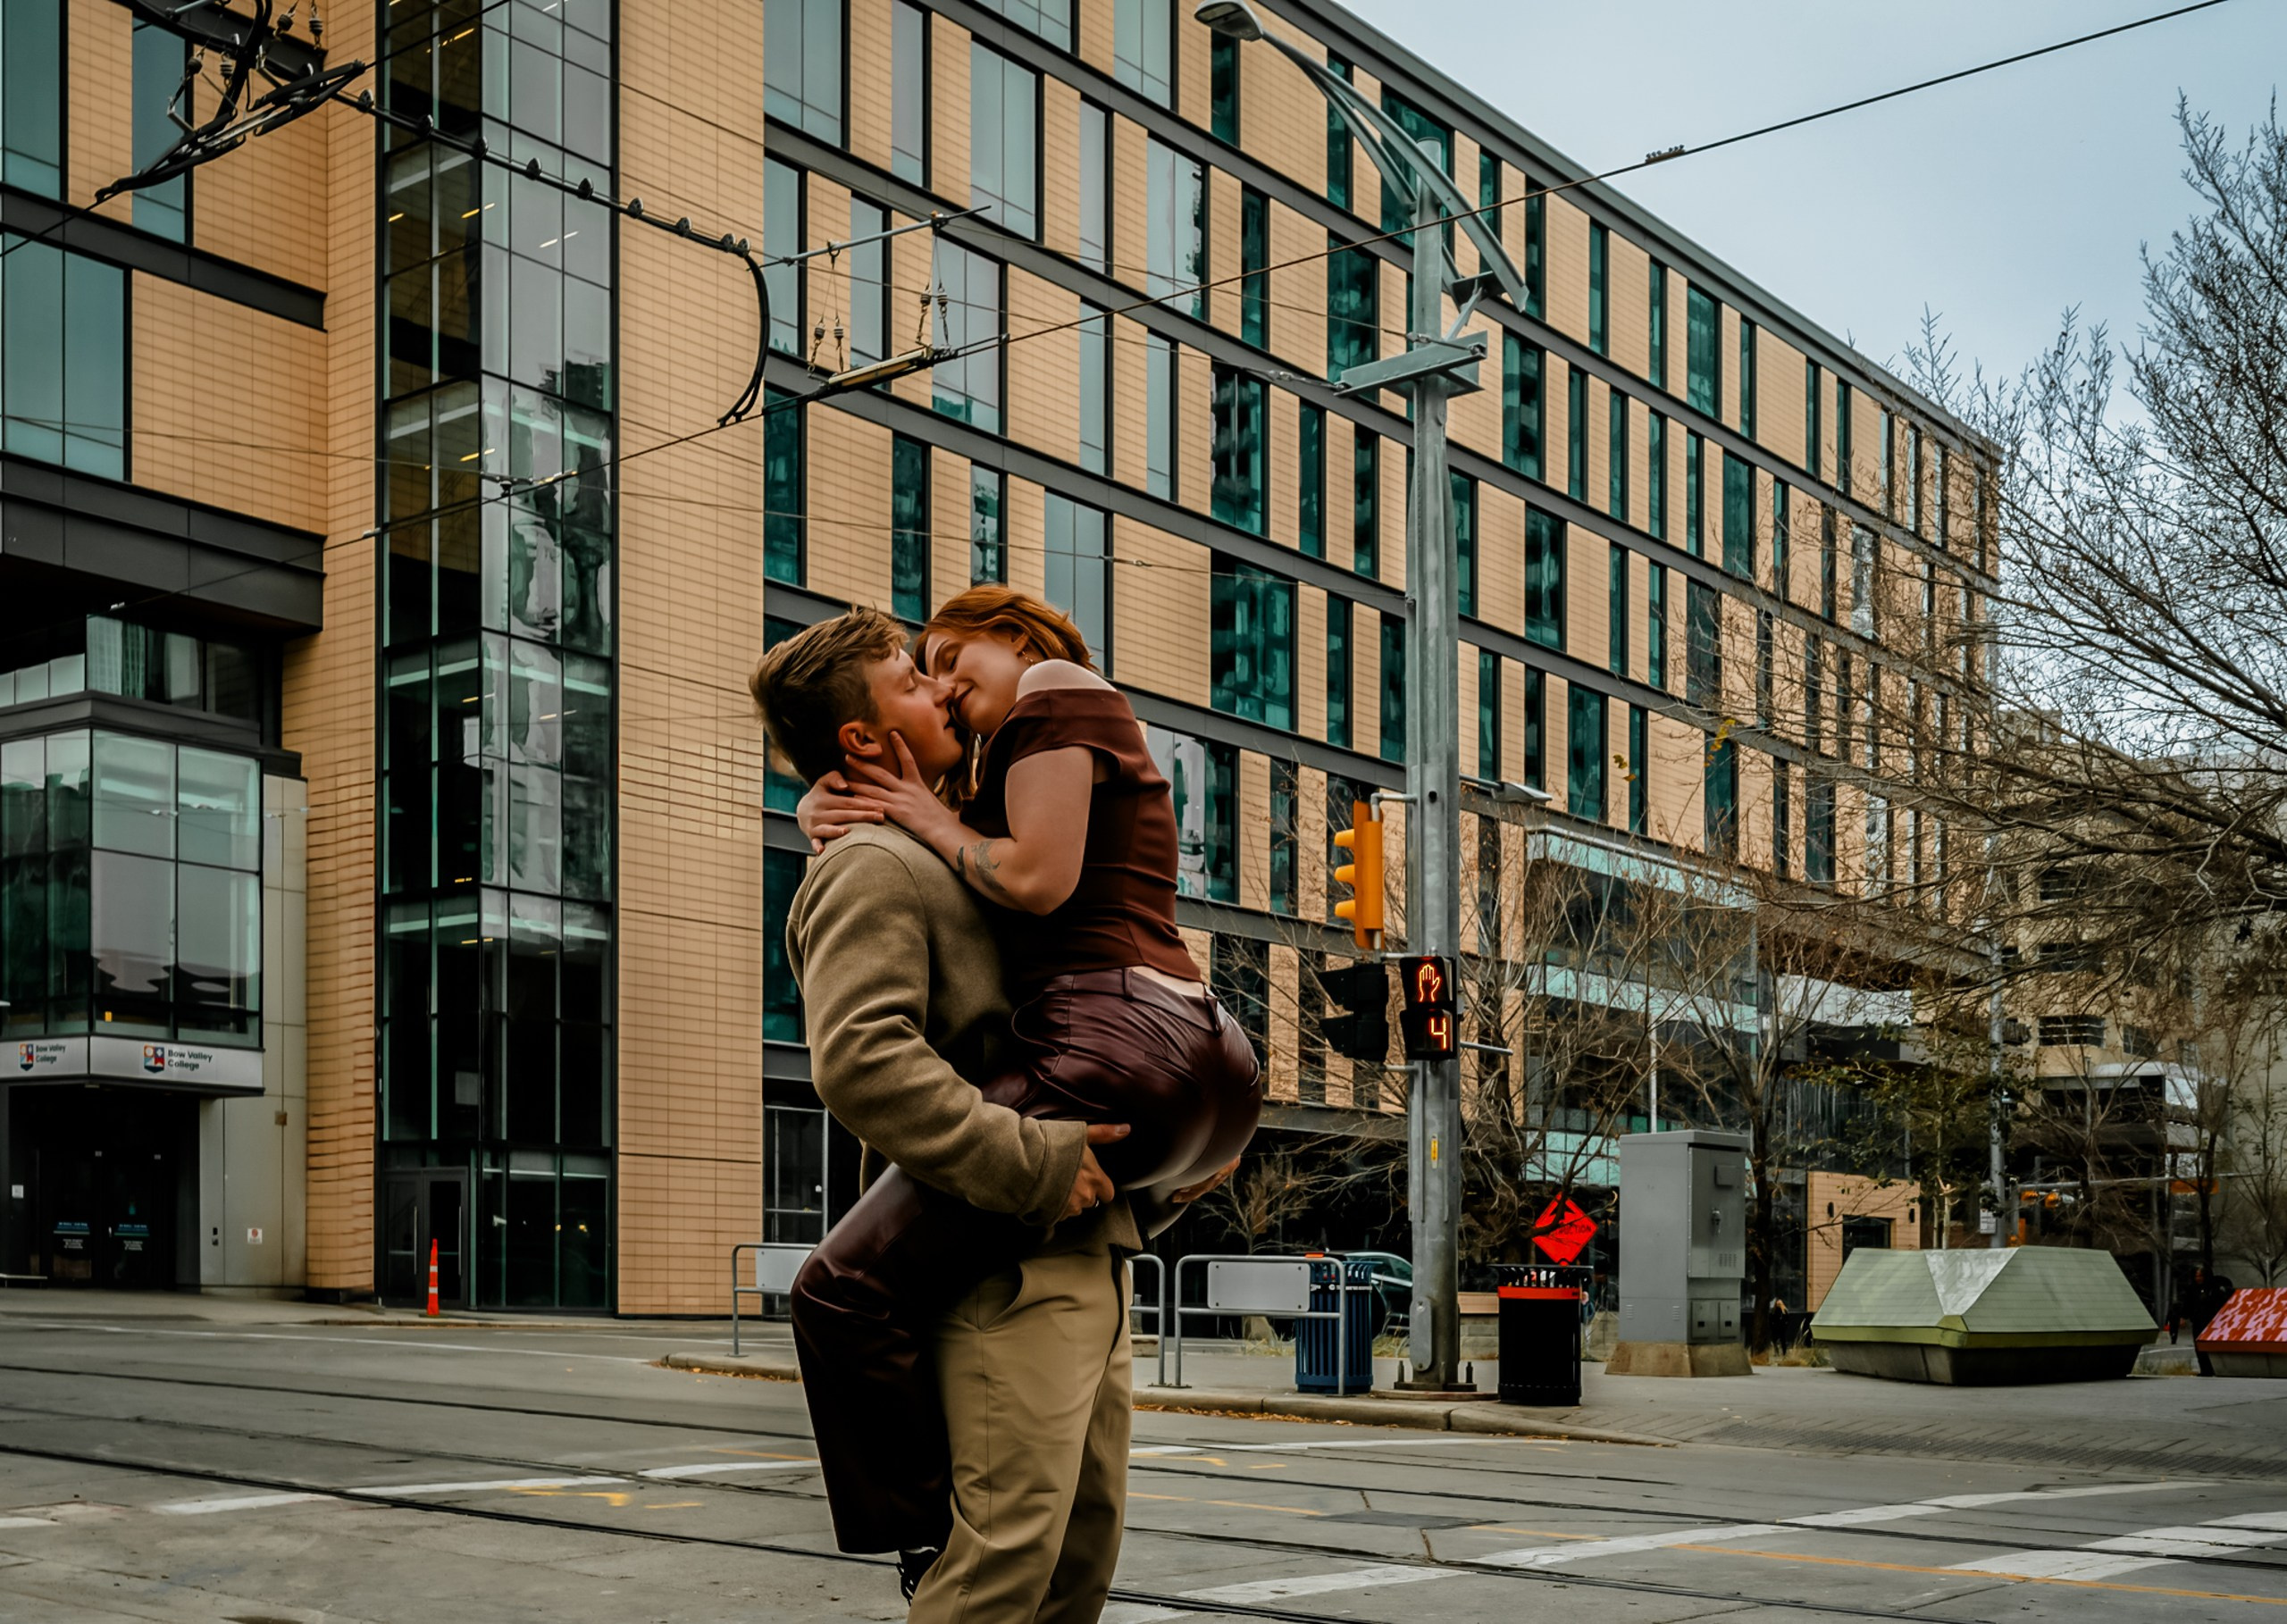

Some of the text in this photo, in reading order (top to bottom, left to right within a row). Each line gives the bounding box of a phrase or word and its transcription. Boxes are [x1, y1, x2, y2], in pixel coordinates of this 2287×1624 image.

[1429, 1017, 1447, 1050] 4
[36, 1043, 66, 1053] Bow Valley
[36, 1054, 57, 1064] College
[168, 1049, 213, 1063] Bow Valley
[168, 1059, 200, 1071] College
